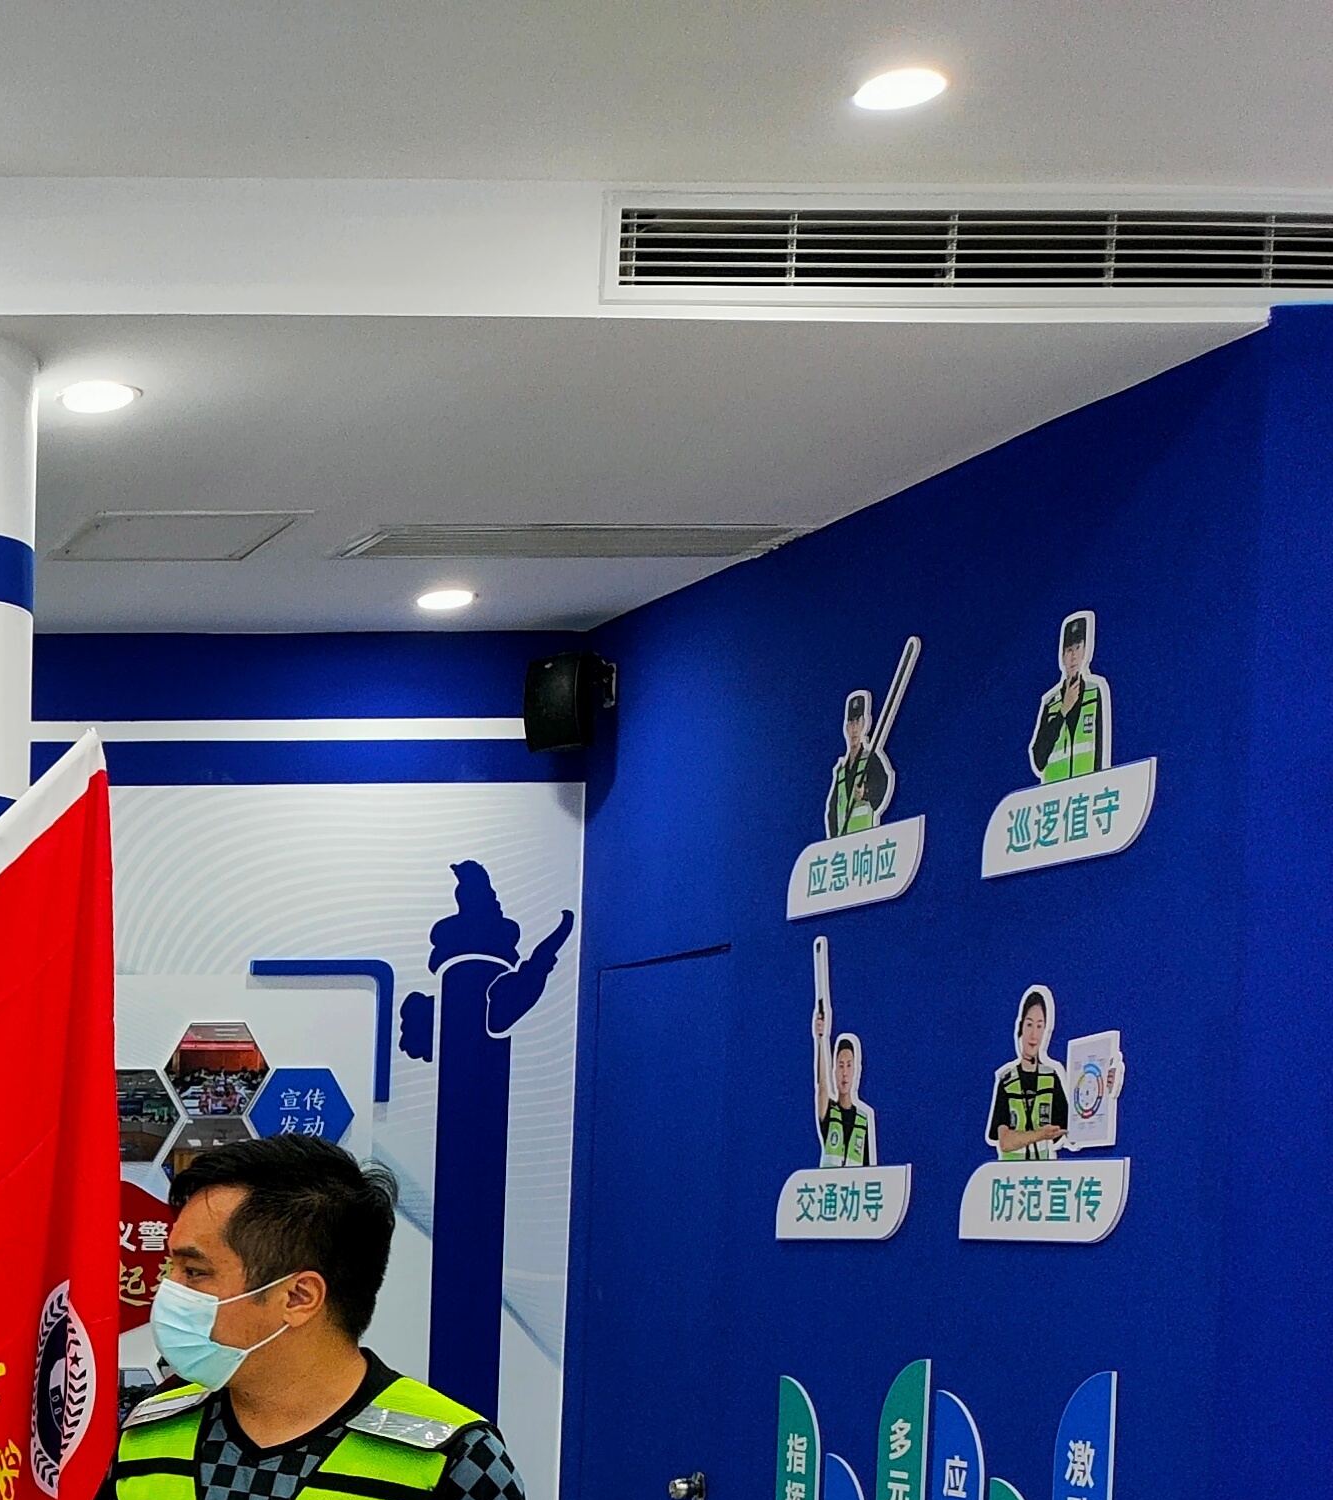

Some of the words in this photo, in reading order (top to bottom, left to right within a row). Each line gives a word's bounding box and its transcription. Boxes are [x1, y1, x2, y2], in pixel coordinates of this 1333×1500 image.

[1006, 787, 1120, 854] 巡逻值守
[807, 838, 897, 898] 应急响应
[279, 1088, 326, 1111] 宣传
[279, 1115, 325, 1137] 发动
[796, 1180, 883, 1223] 交通劝导
[990, 1176, 1103, 1224] 防范宣传
